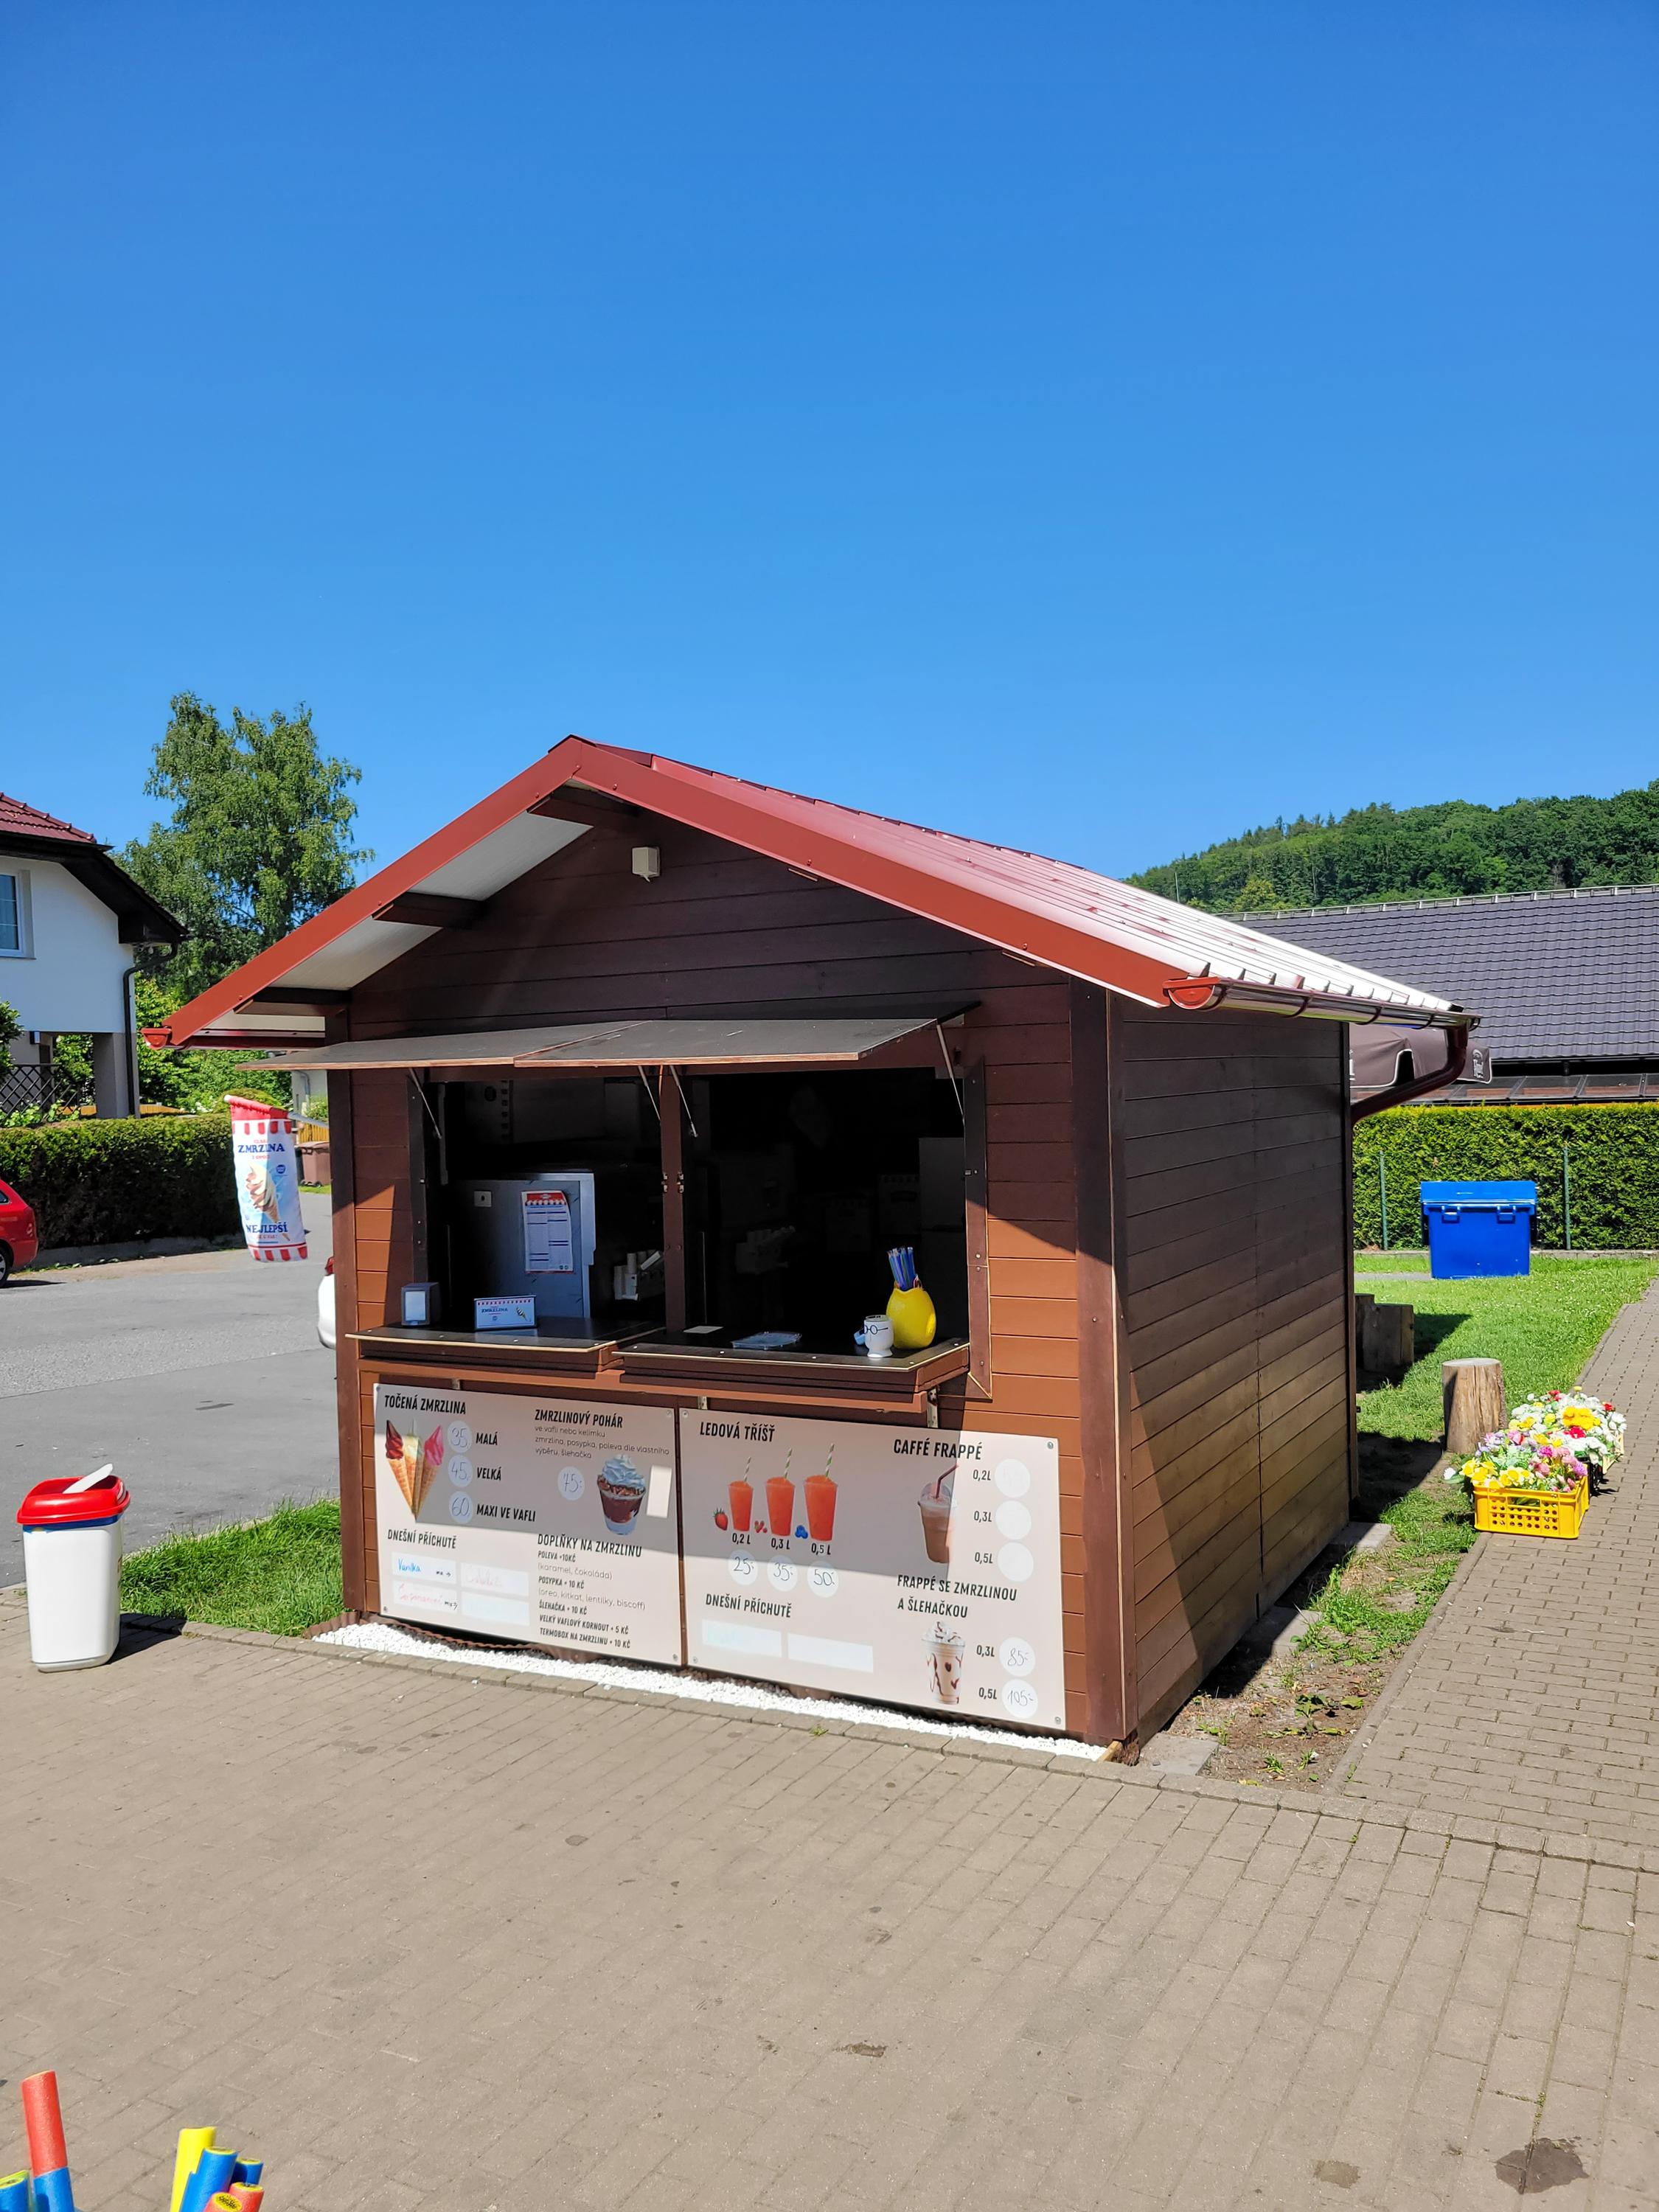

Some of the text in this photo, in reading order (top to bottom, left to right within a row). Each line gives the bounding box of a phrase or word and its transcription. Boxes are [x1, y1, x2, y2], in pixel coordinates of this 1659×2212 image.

[246, 1222, 288, 1234] NEJLEPŠÍ
[384, 1394, 467, 1415] TOČENÁ ZMRZLINA
[535, 1409, 624, 1428] ZMRZLINOVÝ POHÁR
[476, 1432, 498, 1446] MALÁ
[700, 1422, 775, 1442] LEDOVÁ TŘÍŠŤ
[535, 1436, 565, 1445] zmrzlina,
[567, 1440, 597, 1449] posypka,
[599, 1442, 622, 1450] poleva
[894, 1438, 983, 1460] CAFFÉ FRAPPÉ
[561, 1449, 592, 1458] šlehačka
[477, 1467, 502, 1481] VELKÁ
[973, 1469, 991, 1481] 0,2L
[476, 1504, 536, 1522] MAXI VE VAFLI
[973, 1511, 992, 1523] 0,3L
[387, 1528, 456, 1549] DNEŠNÍ PŘÍCHUTĚ
[538, 1534, 642, 1557] DOPLŇKY NA ZMRZLINU
[732, 1532, 751, 1545] 0,2 L
[771, 1537, 790, 1551] 0,3 L
[538, 1550, 557, 1560] POLEVA
[811, 1543, 831, 1555] 0,5 L
[974, 1552, 993, 1564] 0,5L
[574, 1567, 613, 1580] čokoláda)
[538, 1576, 563, 1586] POSYPKA
[568, 1579, 575, 1587] 10
[577, 1580, 585, 1589] KČ
[897, 1574, 1018, 1601] FRAPPÉ SE ZMRZLINOU
[539, 1599, 566, 1612] ŠLEHAČKA
[571, 1605, 578, 1613] 10
[580, 1607, 588, 1615] KČ
[560, 1590, 584, 1602] kitkat,
[585, 1594, 615, 1607] lentilky,
[616, 1599, 645, 1611] biscoff)
[706, 1593, 792, 1618] DNEŠNÍ PŘÍCHUTĚ
[897, 1596, 968, 1618] A ŠLEHAČKOU
[540, 1613, 555, 1623] VELKÝ
[557, 1616, 581, 1628] VAFLOVÝ
[582, 1621, 609, 1632] KORNOUT
[621, 1626, 629, 1635] KČ
[540, 1627, 568, 1639] TERMOBOX
[570, 1632, 578, 1641] NA
[579, 1633, 608, 1645] ZMRZLINU
[614, 1639, 621, 1647] 10
[622, 1640, 631, 1649] KČ
[976, 1644, 995, 1658] 0,3L
[978, 1687, 998, 1700] 0,5L
